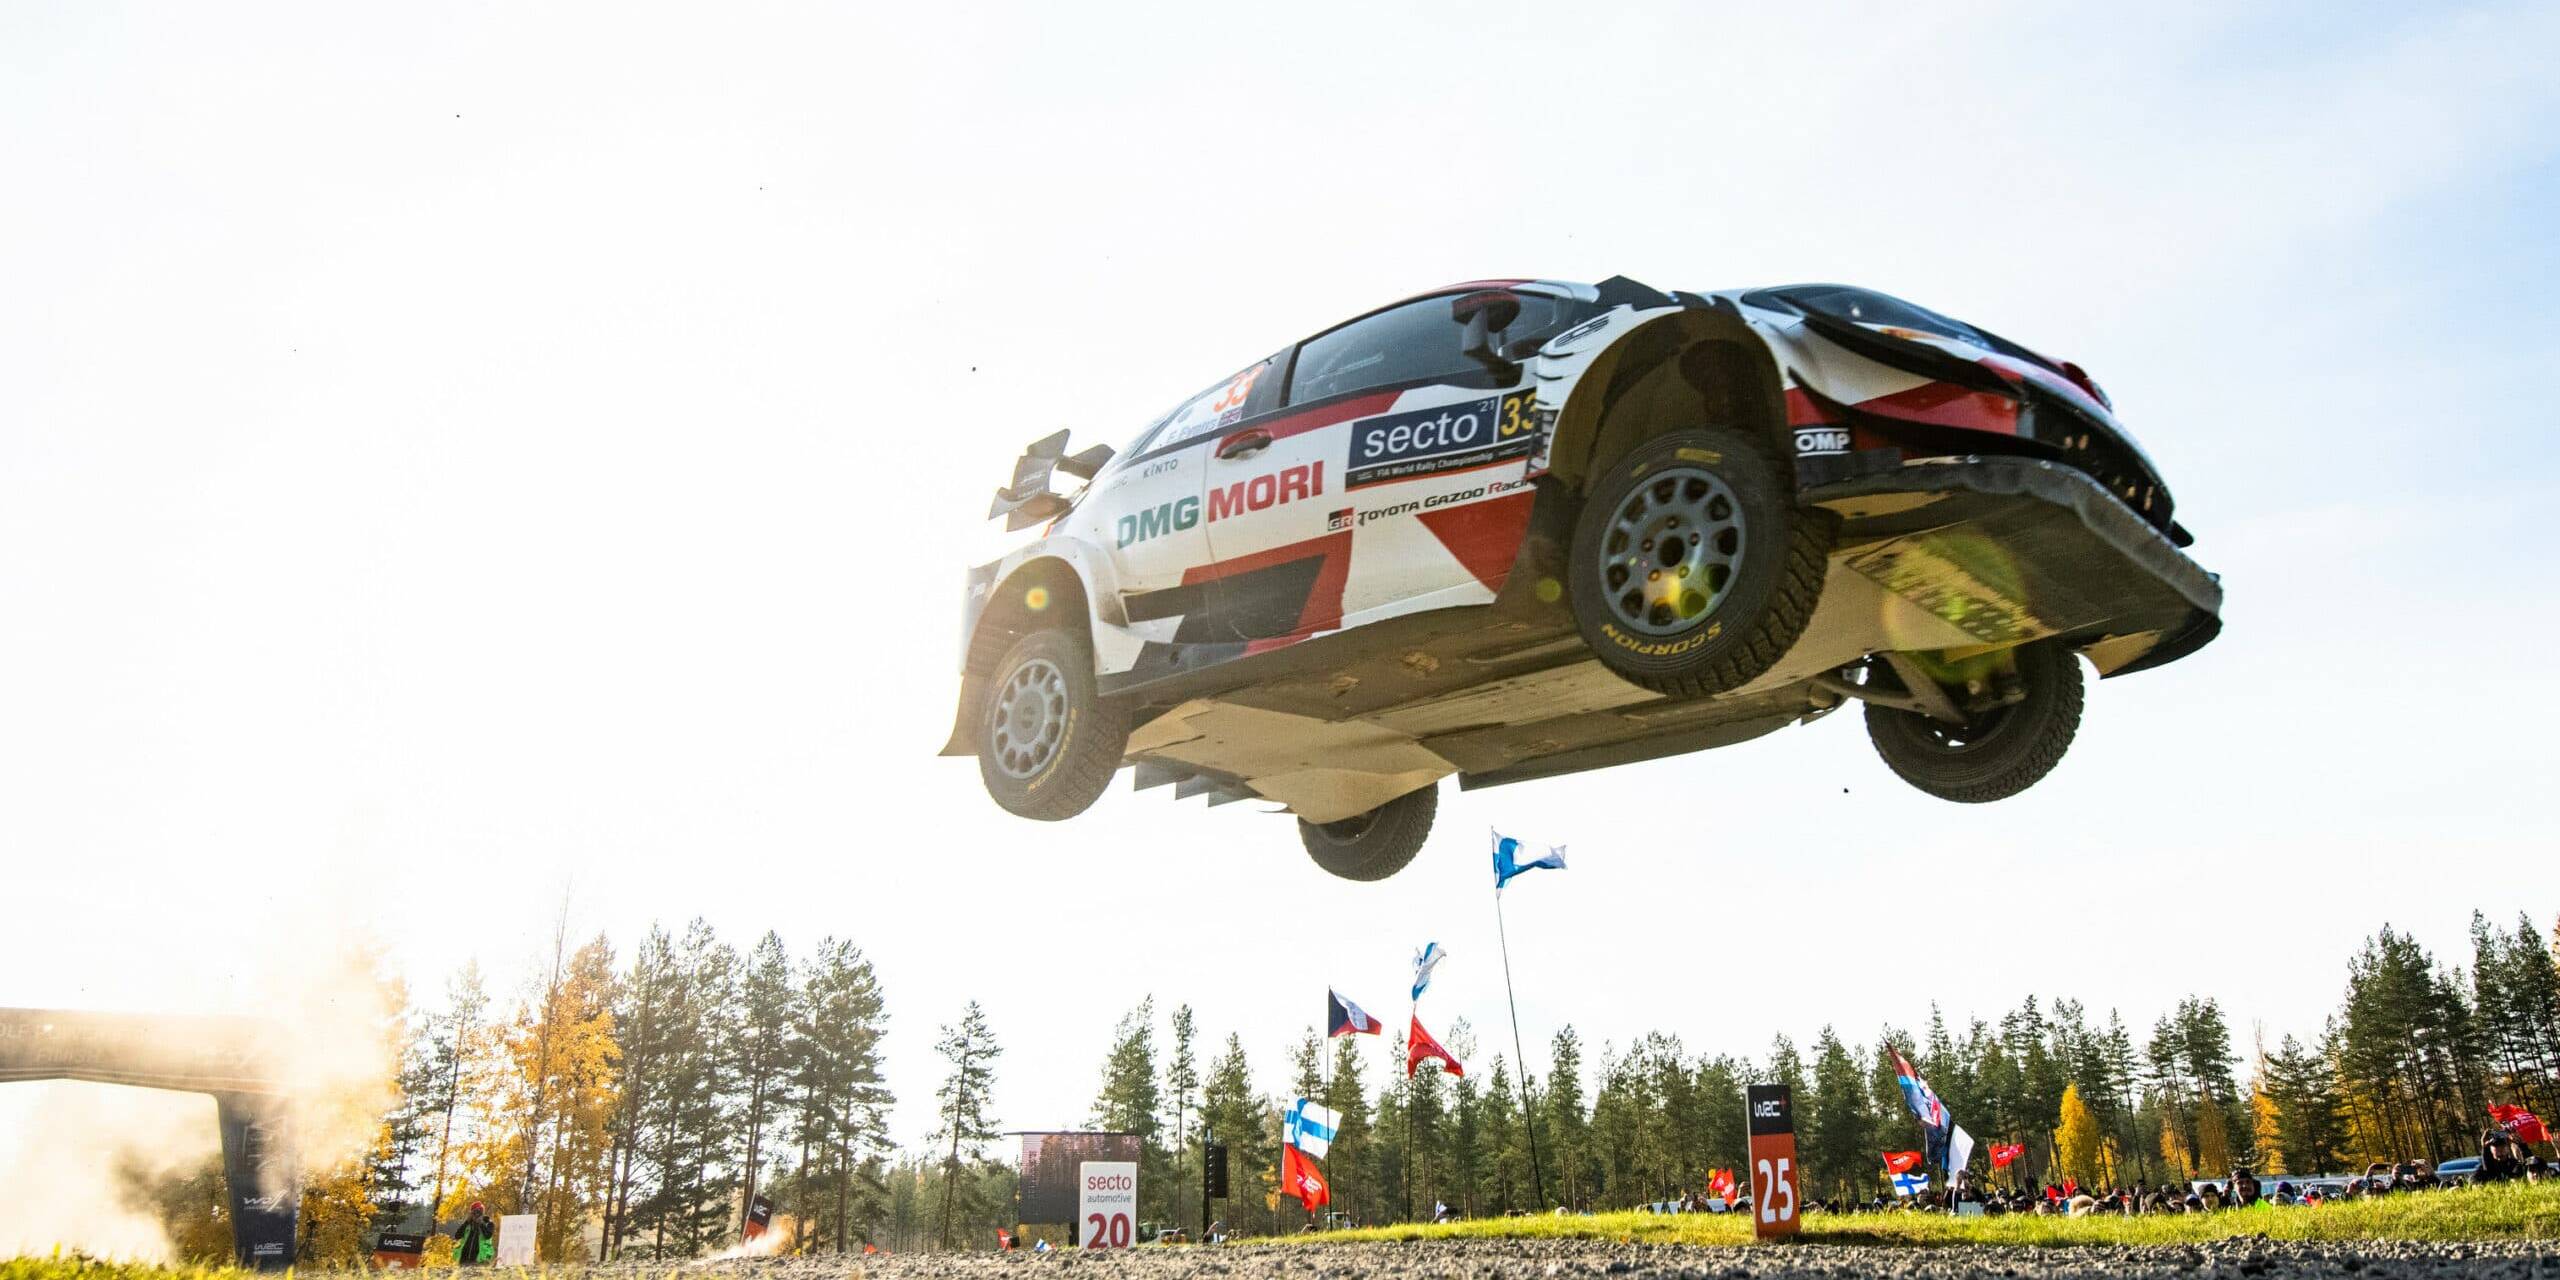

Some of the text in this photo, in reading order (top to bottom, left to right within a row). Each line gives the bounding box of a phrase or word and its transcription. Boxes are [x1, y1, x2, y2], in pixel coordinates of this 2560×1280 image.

[1213, 365, 1265, 413] 33
[1363, 412, 1478, 458] secto
[1796, 434, 1850, 450] OMP
[1143, 459, 1178, 479] KINTO
[1376, 468, 1390, 478] FIA
[1391, 464, 1414, 476] World
[1415, 459, 1436, 472] Rally
[1437, 452, 1494, 470] Championship
[1117, 460, 1325, 550] DMG MORI
[1357, 501, 1420, 526] TOYOTA
[1424, 488, 1484, 509] GAZOO
[1600, 622, 1721, 655] SCORPION
[1087, 1173, 1132, 1190] secto
[1087, 1193, 1132, 1204] automotive
[1758, 1158, 1794, 1223] 25
[1087, 1212, 1131, 1249] 20
